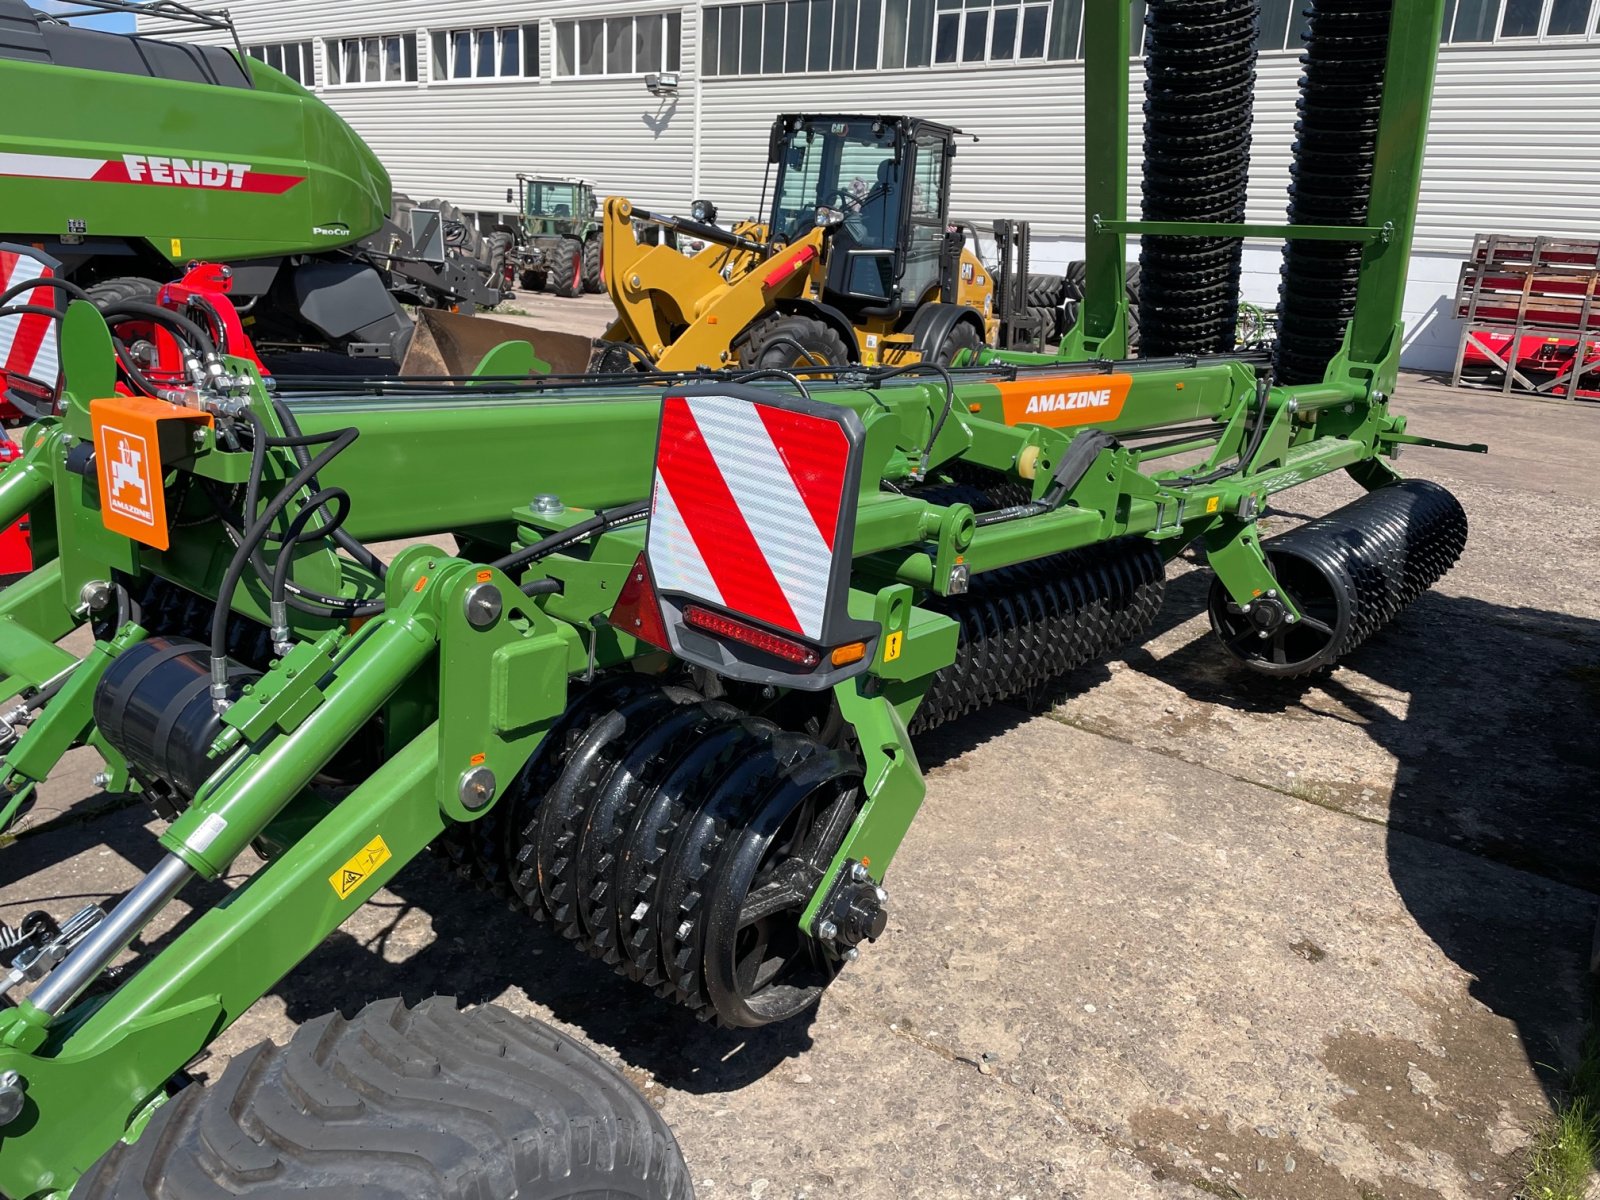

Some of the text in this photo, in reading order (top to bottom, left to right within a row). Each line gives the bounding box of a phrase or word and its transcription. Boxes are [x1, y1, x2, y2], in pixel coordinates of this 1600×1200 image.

[831, 123, 845, 133] CAT
[122, 154, 251, 188] FENDT
[962, 263, 973, 280] CAT
[1025, 389, 1111, 414] AMAZONE
[112, 499, 152, 520] AMAZONE
